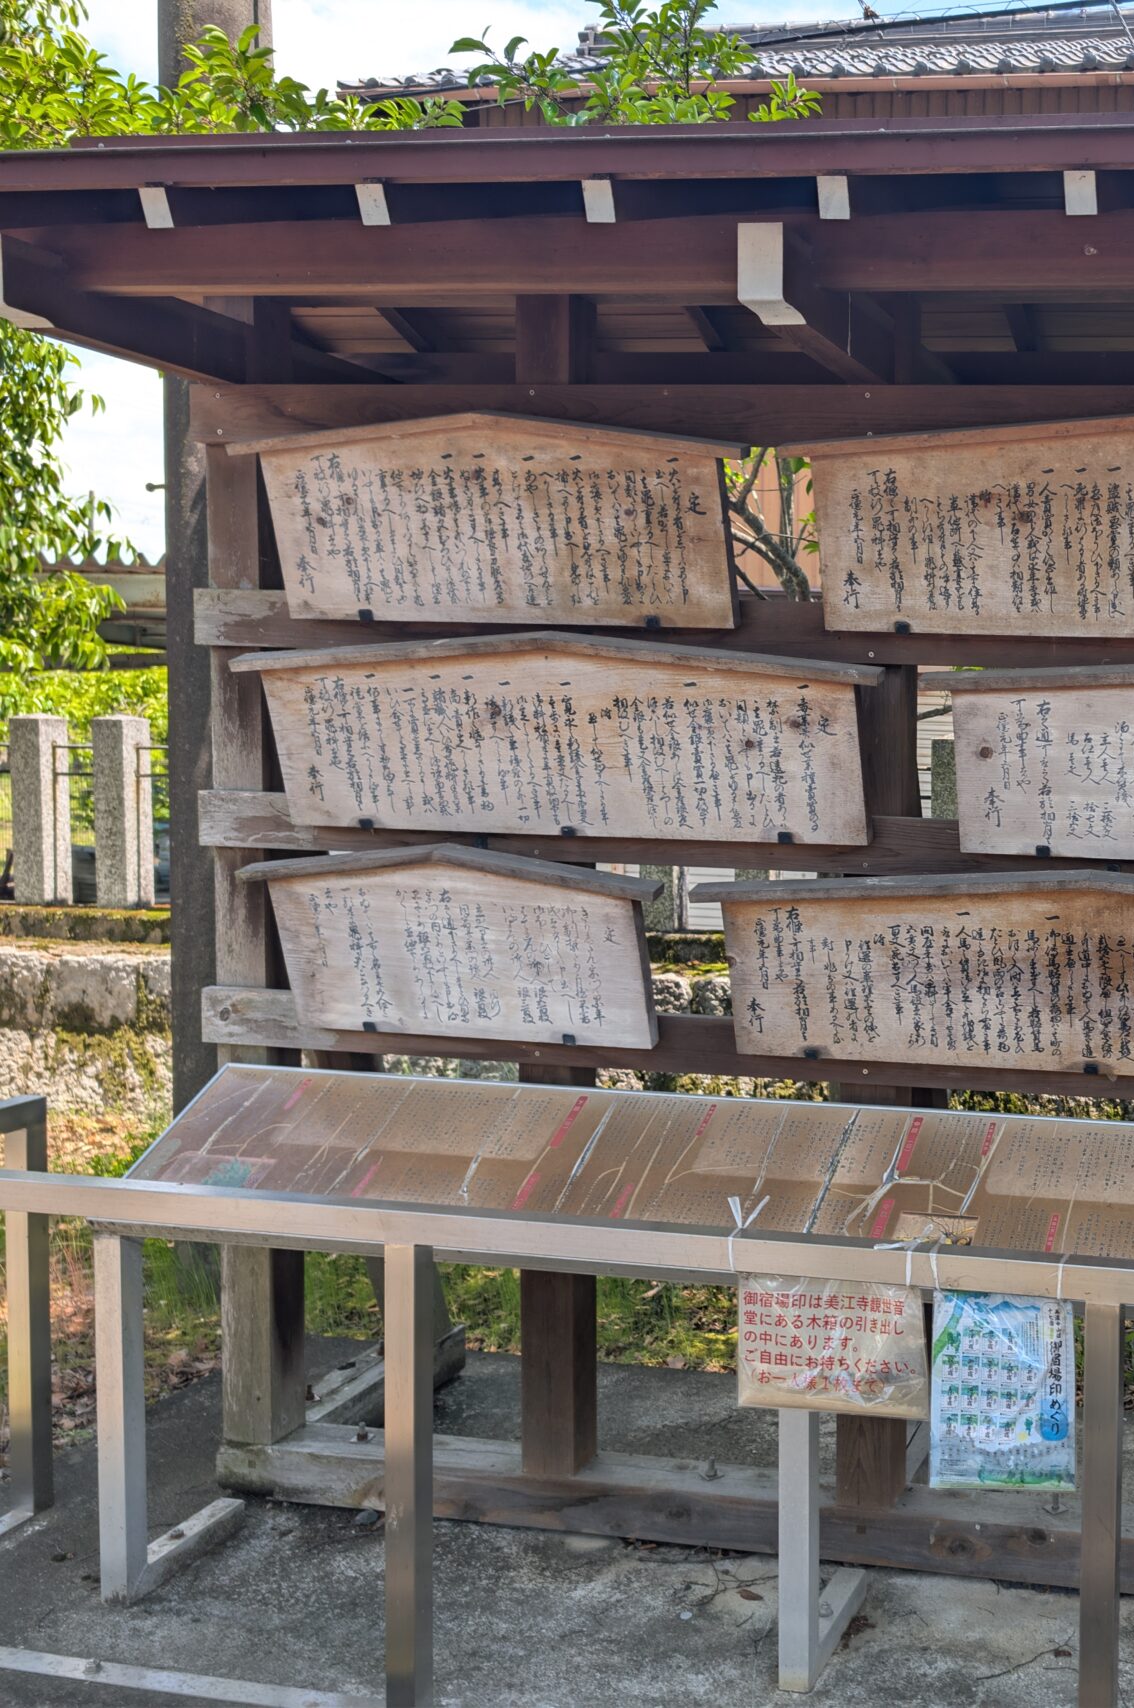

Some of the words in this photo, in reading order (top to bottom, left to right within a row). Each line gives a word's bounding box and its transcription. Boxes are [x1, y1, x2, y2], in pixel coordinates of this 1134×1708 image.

[685, 492, 708, 516] 定
[843, 570, 863, 610] 奉行
[817, 714, 838, 737] 定
[982, 786, 1006, 829] 奉行
[602, 927, 623, 946] 定
[746, 997, 766, 1034] 奉行
[743, 1290, 905, 1317] 御宿場印は美江寺観世音
[743, 1310, 905, 1336] 堂にある木箱の引き出し
[744, 1330, 859, 1353] の中にあります。
[744, 1347, 918, 1375] ご自由にお持ちください。
[1048, 1340, 1063, 1436] 御宿場印めぐり
